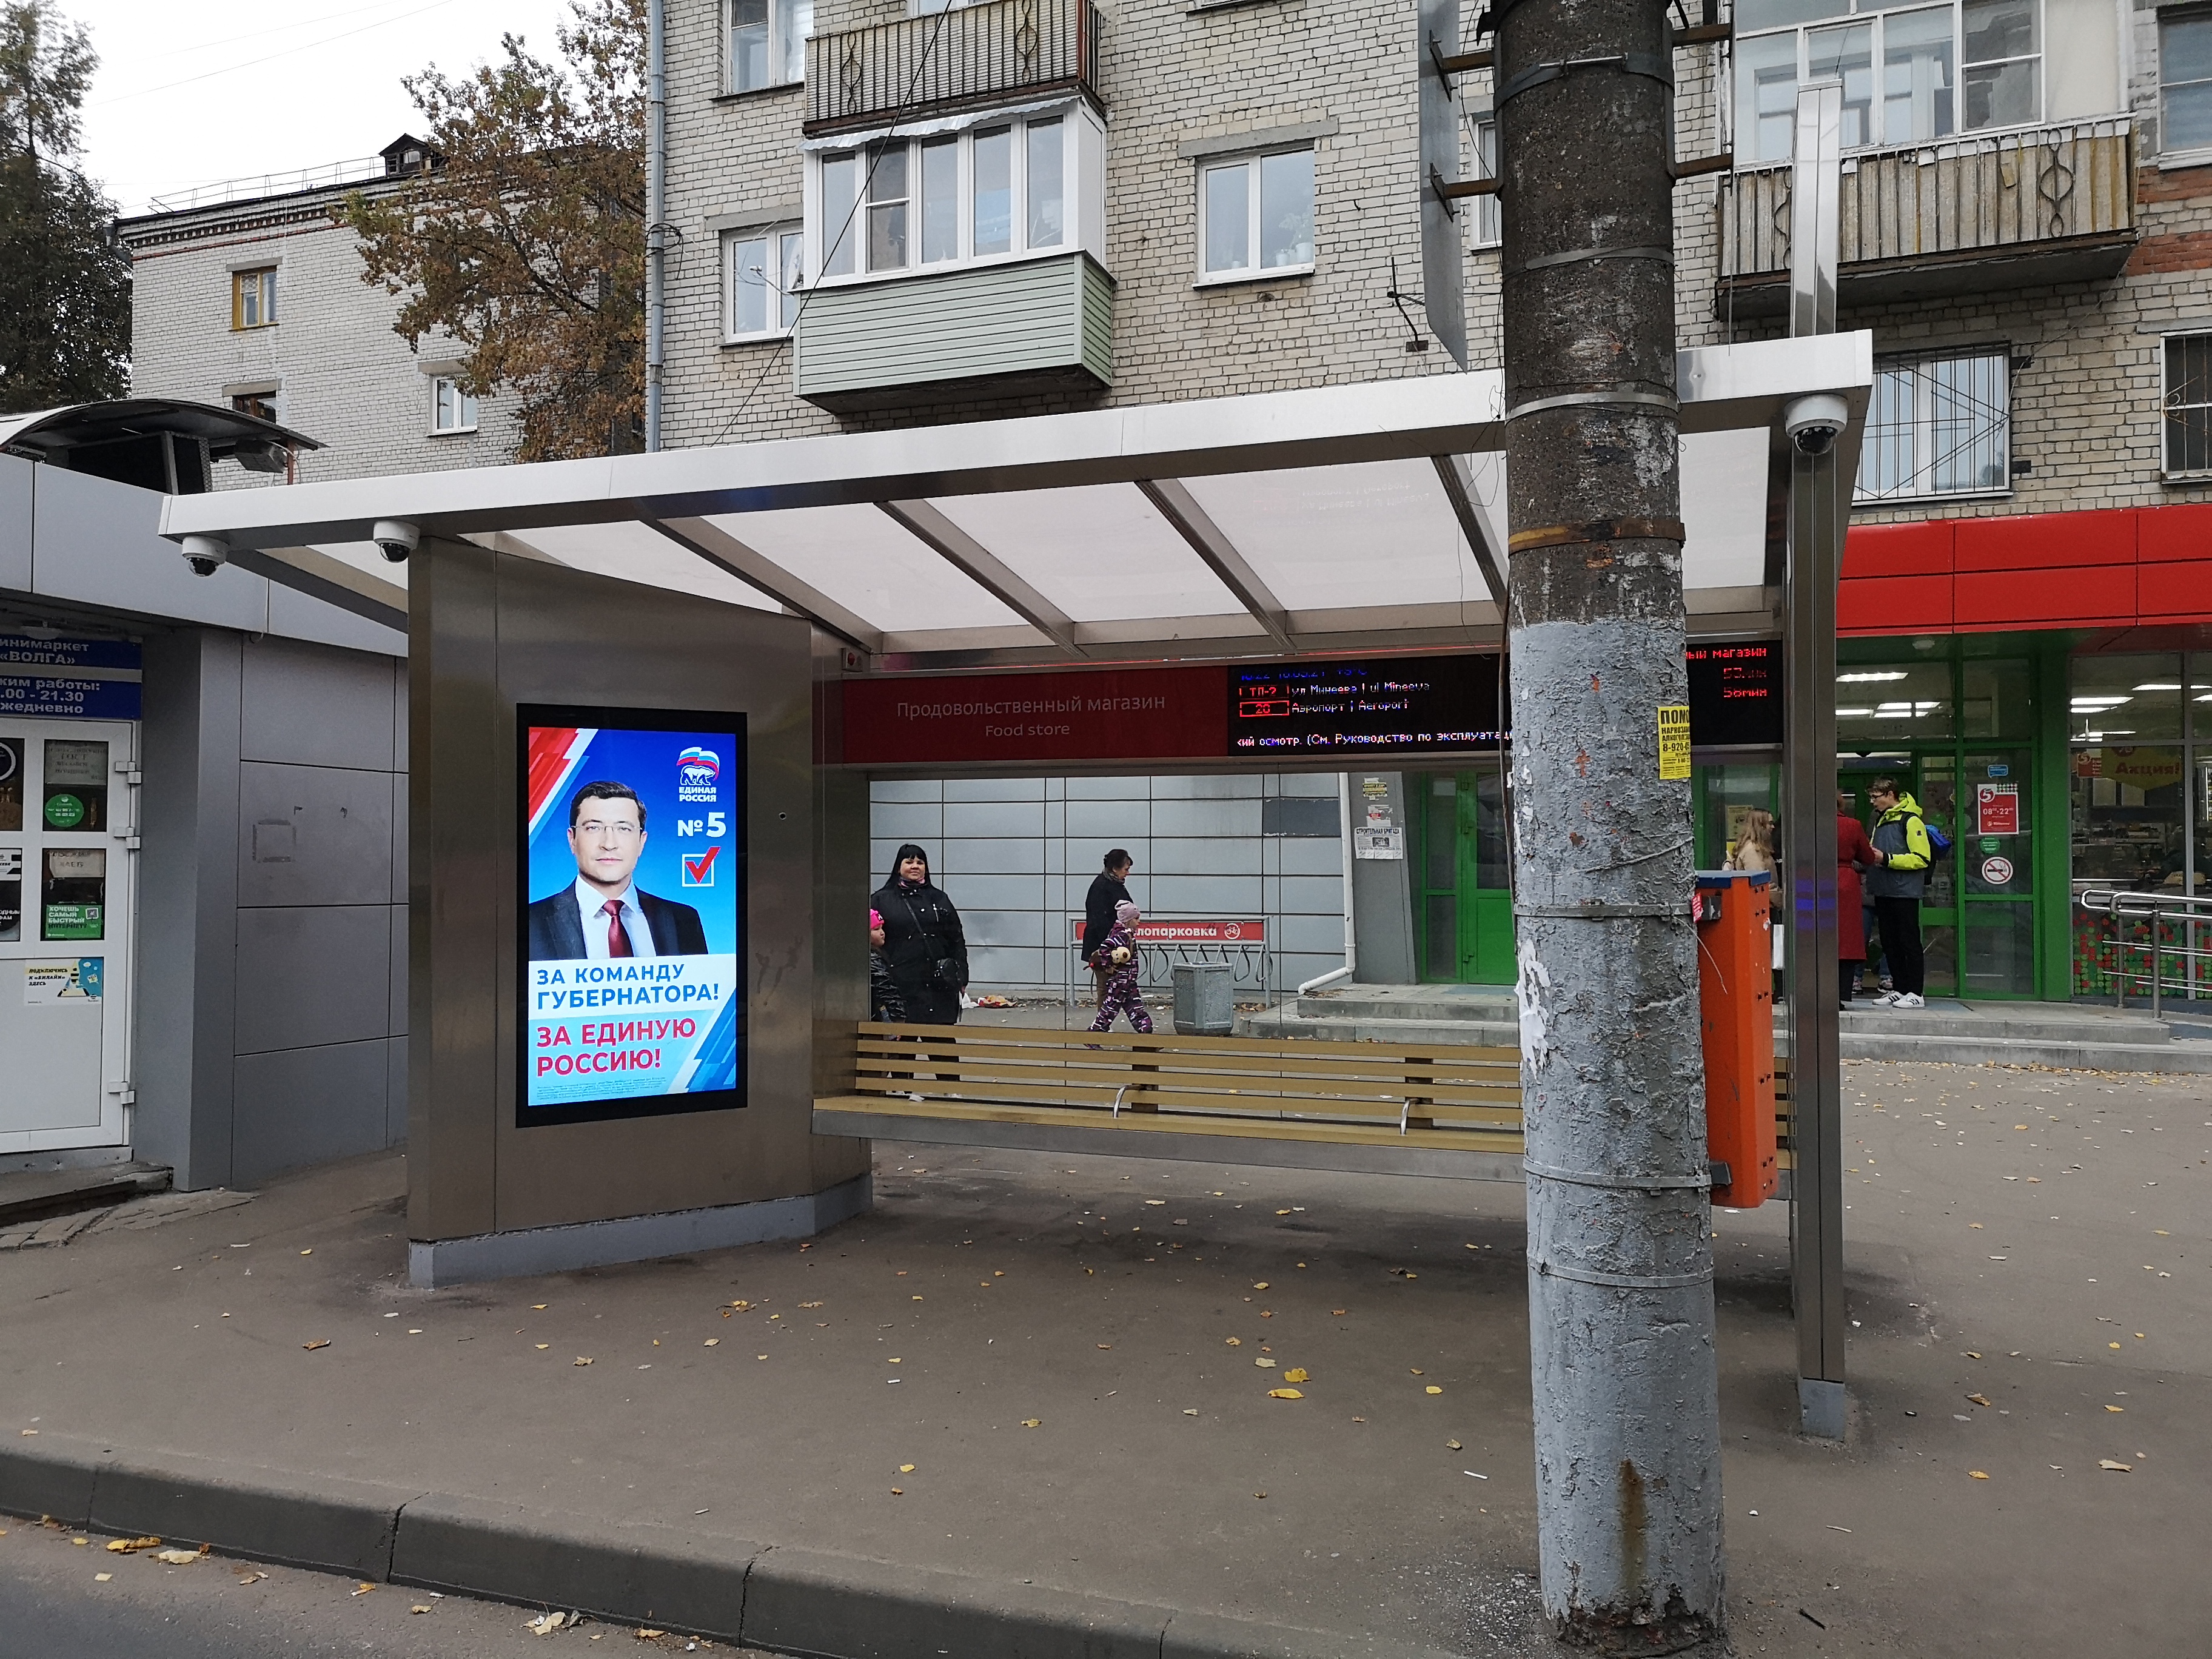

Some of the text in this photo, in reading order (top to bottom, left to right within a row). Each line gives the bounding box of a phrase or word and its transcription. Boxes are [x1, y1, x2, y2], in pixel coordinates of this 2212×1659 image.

[0, 651, 76, 664] «ВОЛГА»
[1713, 648, 1767, 659] магазин
[36, 679, 101, 691] работы:
[1292, 688, 1306, 697] ул
[1310, 684, 1357, 695] Минеева
[1370, 682, 1379, 692] ul
[40, 690, 84, 702] 21.30
[0, 702, 84, 714] жедневно
[897, 695, 1165, 721] Продовольственный магазин
[1255, 703, 1270, 714] 20
[1292, 702, 1346, 714] Аэропорт
[1358, 698, 1410, 711] Aeroport
[985, 722, 1071, 737] Food store
[1259, 737, 1304, 746] осмотр.
[1307, 732, 1331, 746] (См.
[1335, 732, 1413, 745] Руководство
[1418, 732, 1432, 742] по
[2114, 762, 2179, 776] Акция!
[537, 963, 685, 985] ЗА КОМАНДУ
[538, 982, 719, 1010] ГУБЕРНАТОРА!
[536, 1017, 697, 1048] ЗА ЕДИНУЮ
[537, 1048, 661, 1078] РОССИЮ!
